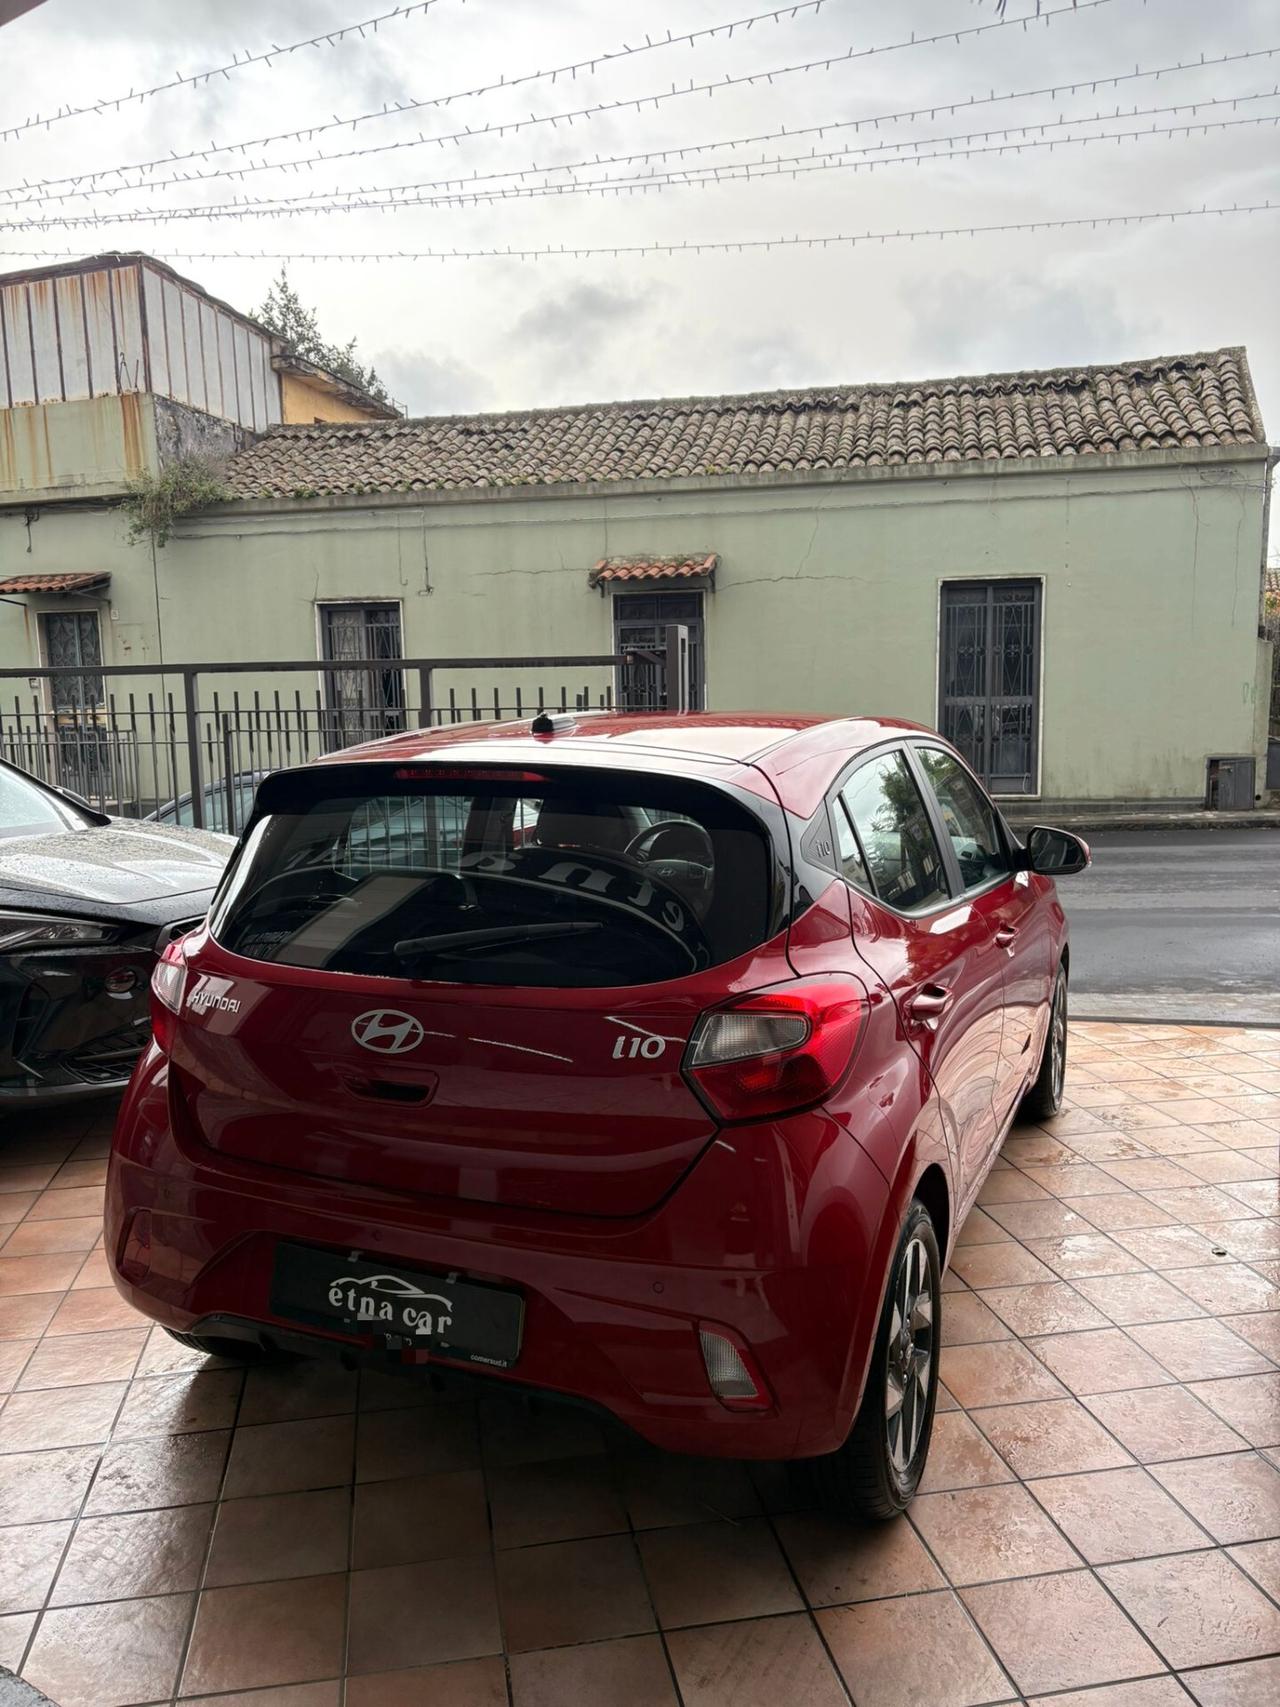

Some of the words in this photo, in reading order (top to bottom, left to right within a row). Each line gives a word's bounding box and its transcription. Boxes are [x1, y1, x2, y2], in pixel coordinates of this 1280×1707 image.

[192, 992, 241, 1013] HYUNDAI
[328, 1286, 393, 1321] etna
[402, 1307, 452, 1335] car
